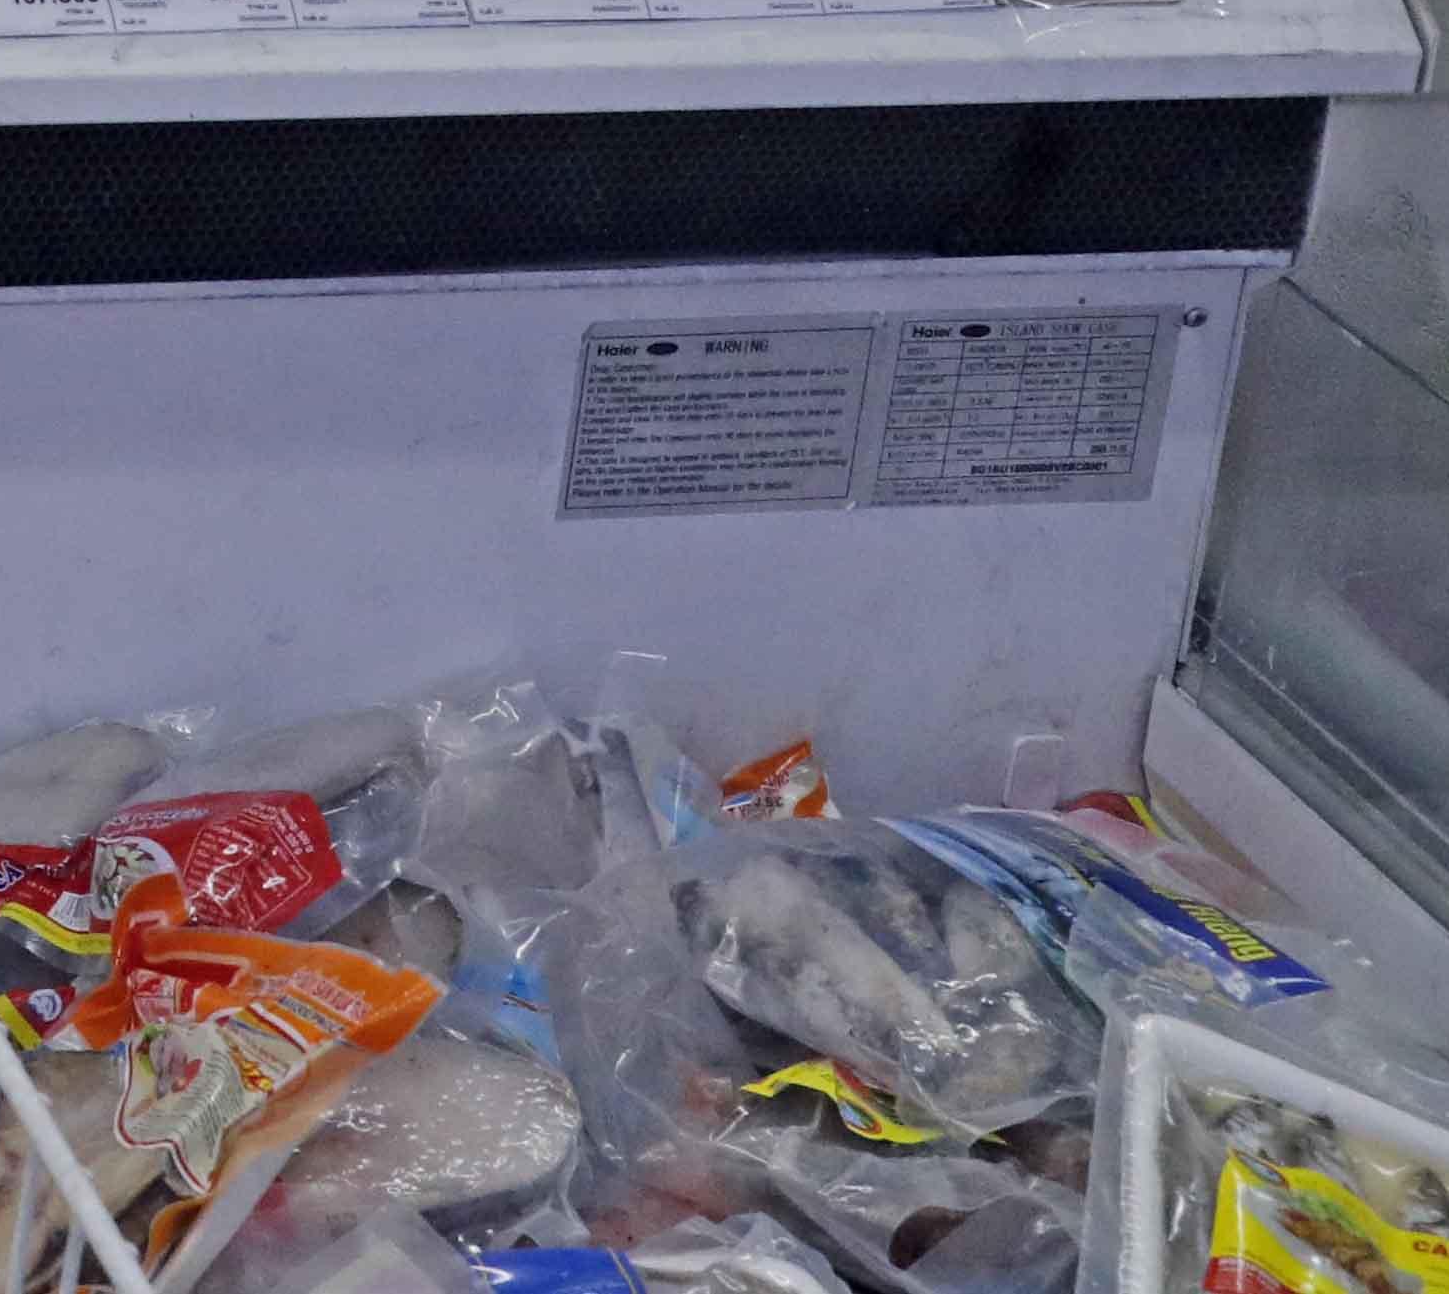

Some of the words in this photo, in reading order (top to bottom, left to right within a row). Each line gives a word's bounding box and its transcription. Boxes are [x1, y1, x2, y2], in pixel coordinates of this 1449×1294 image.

[911, 325, 951, 338] Haier
[596, 344, 640, 357] Haier
[705, 339, 770, 355] WARNING
